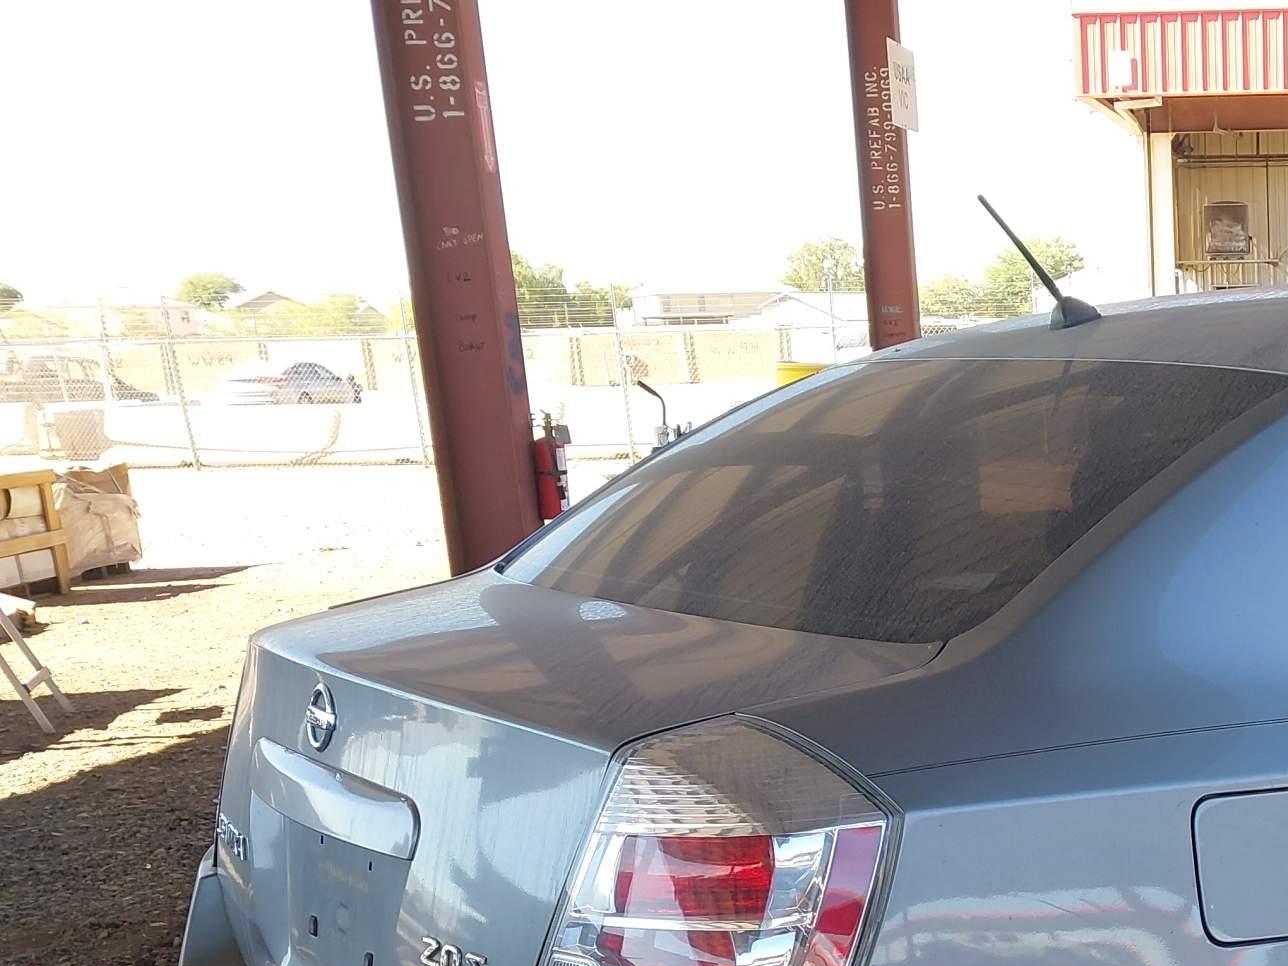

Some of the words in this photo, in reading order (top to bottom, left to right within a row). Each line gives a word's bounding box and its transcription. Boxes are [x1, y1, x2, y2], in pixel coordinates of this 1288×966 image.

[400, 0, 427, 45] PR
[410, 65, 436, 121] U.S.
[864, 66, 878, 98] INC.
[867, 106, 883, 170] PREFAB
[872, 179, 886, 211] U.S.
